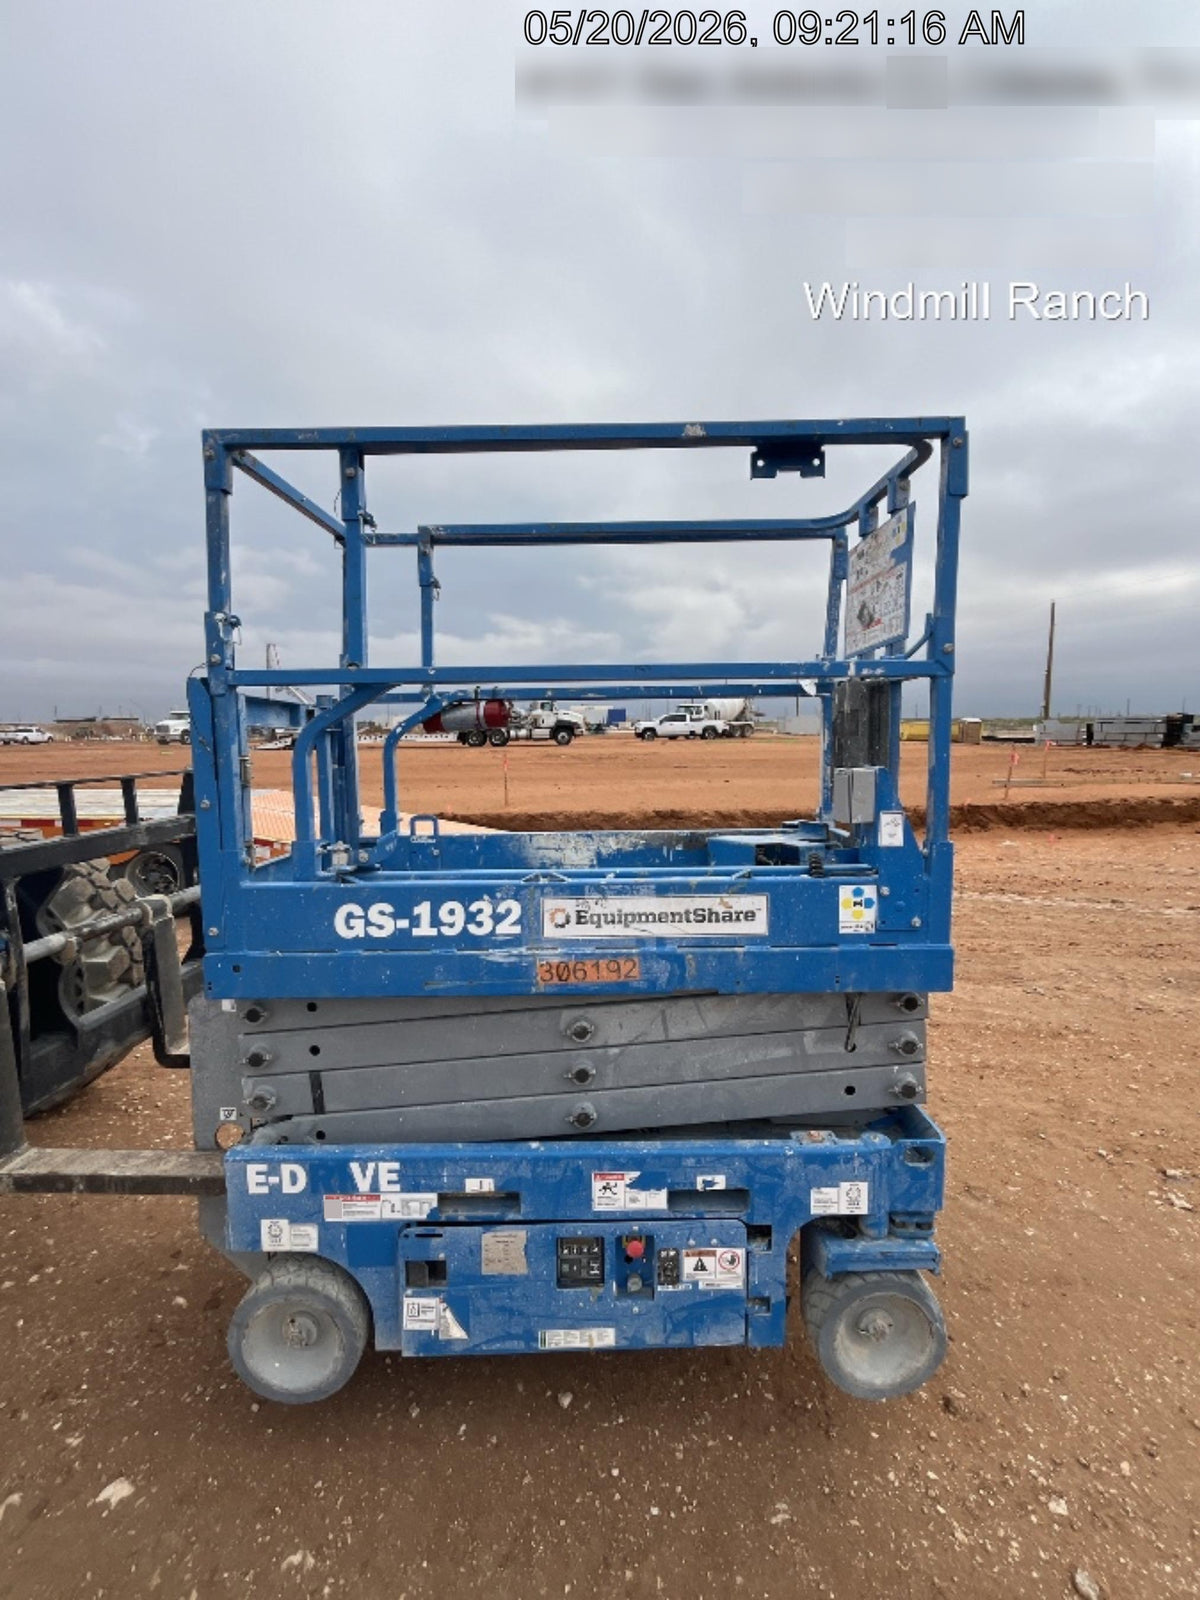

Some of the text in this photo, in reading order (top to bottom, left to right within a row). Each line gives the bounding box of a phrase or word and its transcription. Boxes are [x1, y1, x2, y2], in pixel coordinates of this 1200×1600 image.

[334, 899, 522, 939] GS-1932
[575, 907, 757, 929] EquipmentShare
[539, 958, 638, 983] 306192
